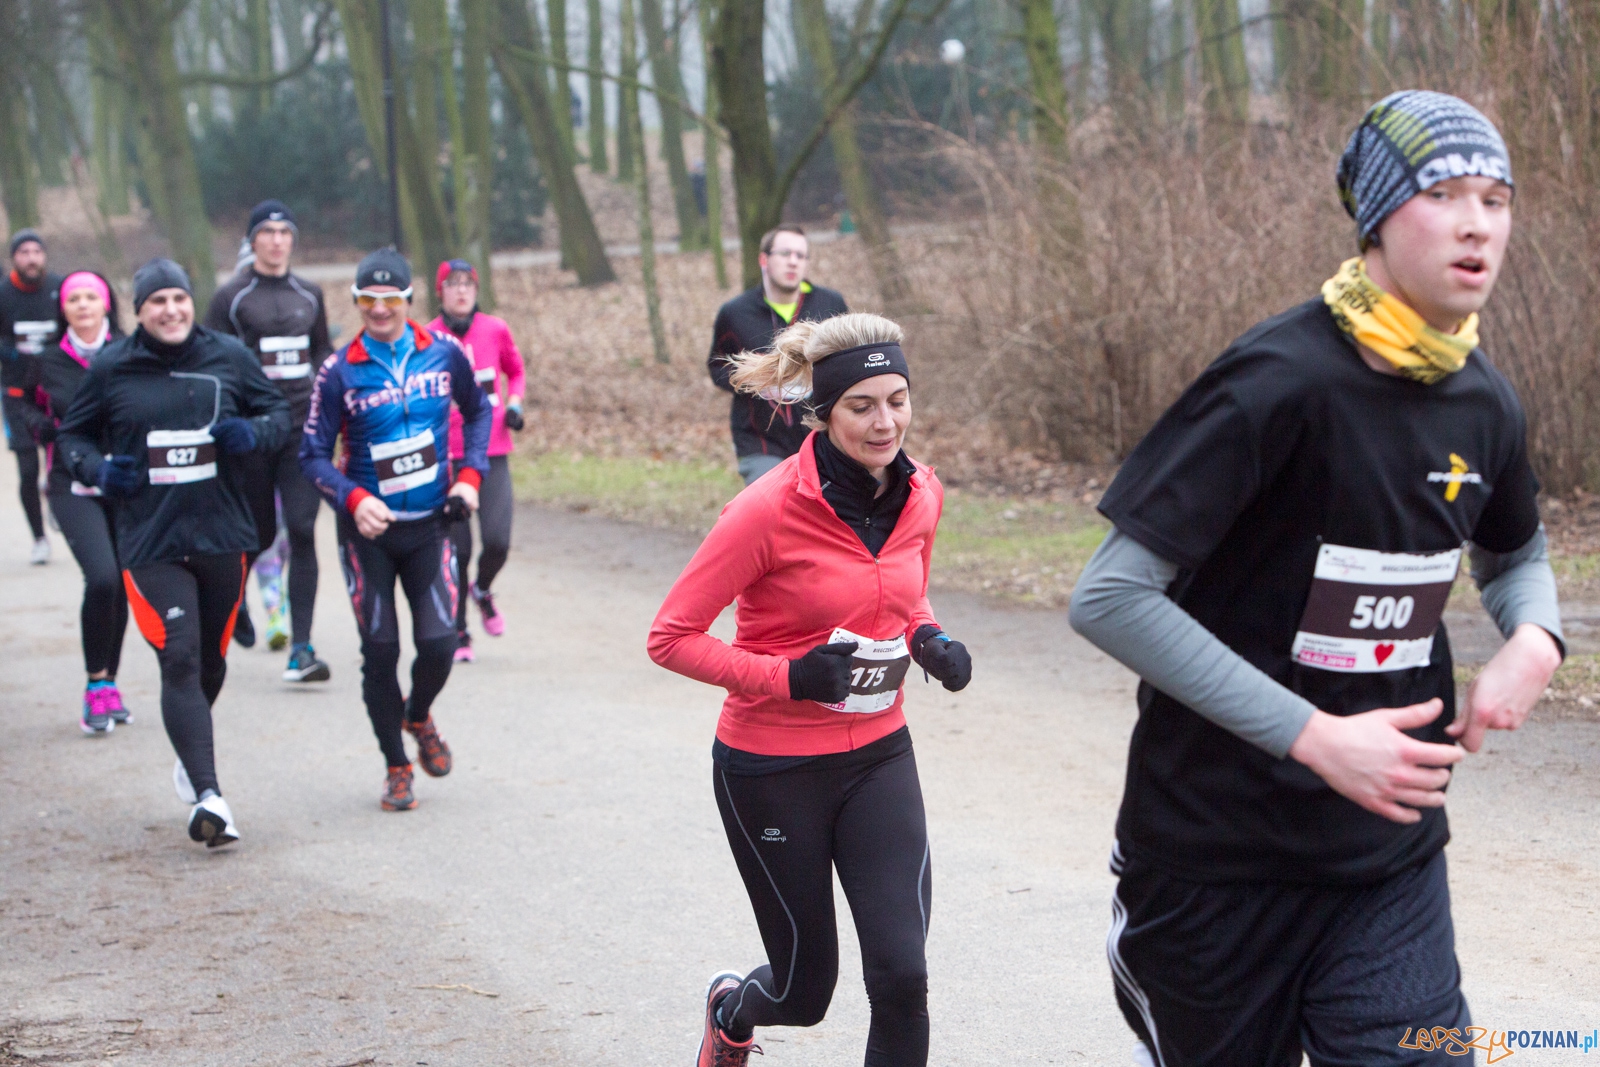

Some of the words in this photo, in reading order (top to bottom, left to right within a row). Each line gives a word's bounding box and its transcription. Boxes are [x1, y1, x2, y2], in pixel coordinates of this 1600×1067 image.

[166, 447, 198, 466] 627
[392, 452, 425, 475] 632
[1349, 595, 1415, 629] 500
[850, 666, 888, 688] 175
